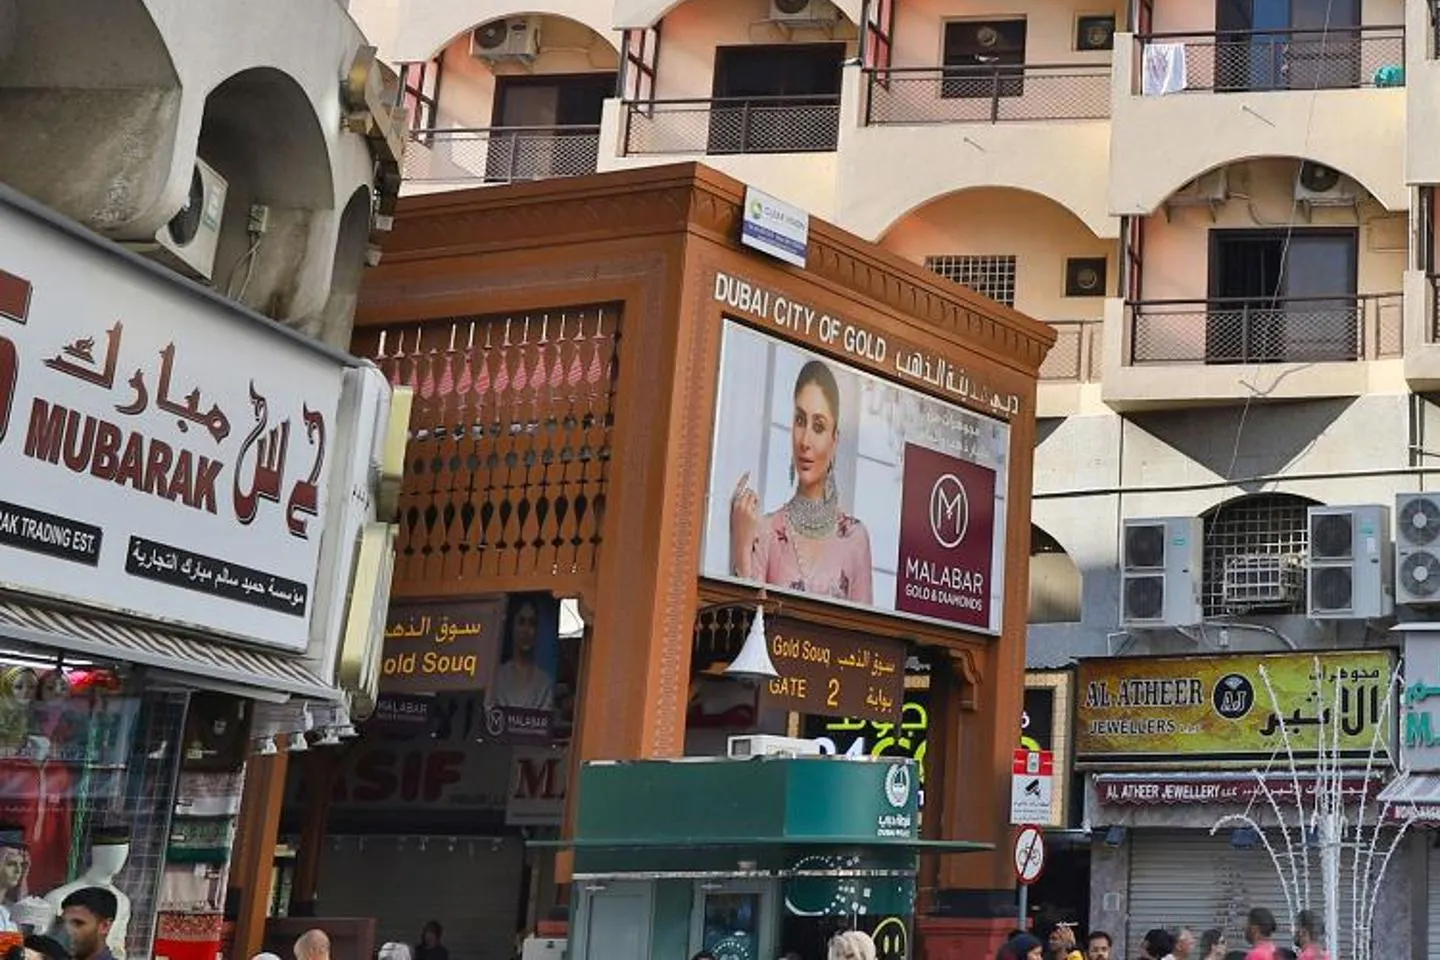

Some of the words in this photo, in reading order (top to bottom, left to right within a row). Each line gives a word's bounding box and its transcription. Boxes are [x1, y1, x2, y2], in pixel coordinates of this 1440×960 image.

[715, 273, 768, 318] DUBAI
[774, 296, 815, 335] CITY
[818, 314, 842, 344] OF
[844, 325, 887, 363] GOLD
[42, 320, 232, 443] مبارك
[24, 397, 224, 515] MUBARAK
[20, 515, 72, 550] TRADING
[72, 531, 96, 555] EST.
[905, 555, 984, 595] MALABAR
[905, 583, 930, 601] GOLD
[938, 591, 983, 612] DIAMONDS
[434, 617, 482, 643] سوق
[382, 651, 416, 675] old
[422, 651, 478, 678] Souq
[773, 634, 801, 658] Gold
[801, 640, 831, 669] Souq
[769, 677, 807, 698] GATE
[827, 678, 840, 708] 2
[865, 686, 893, 714] بوابة
[1086, 680, 1110, 707] AL
[1117, 677, 1204, 707] ATHEER
[1089, 718, 1176, 735] JEWELLERS
[1106, 783, 1119, 800] AL
[1120, 783, 1159, 800] ATHEER
[1161, 783, 1221, 800] JEWELLERY
